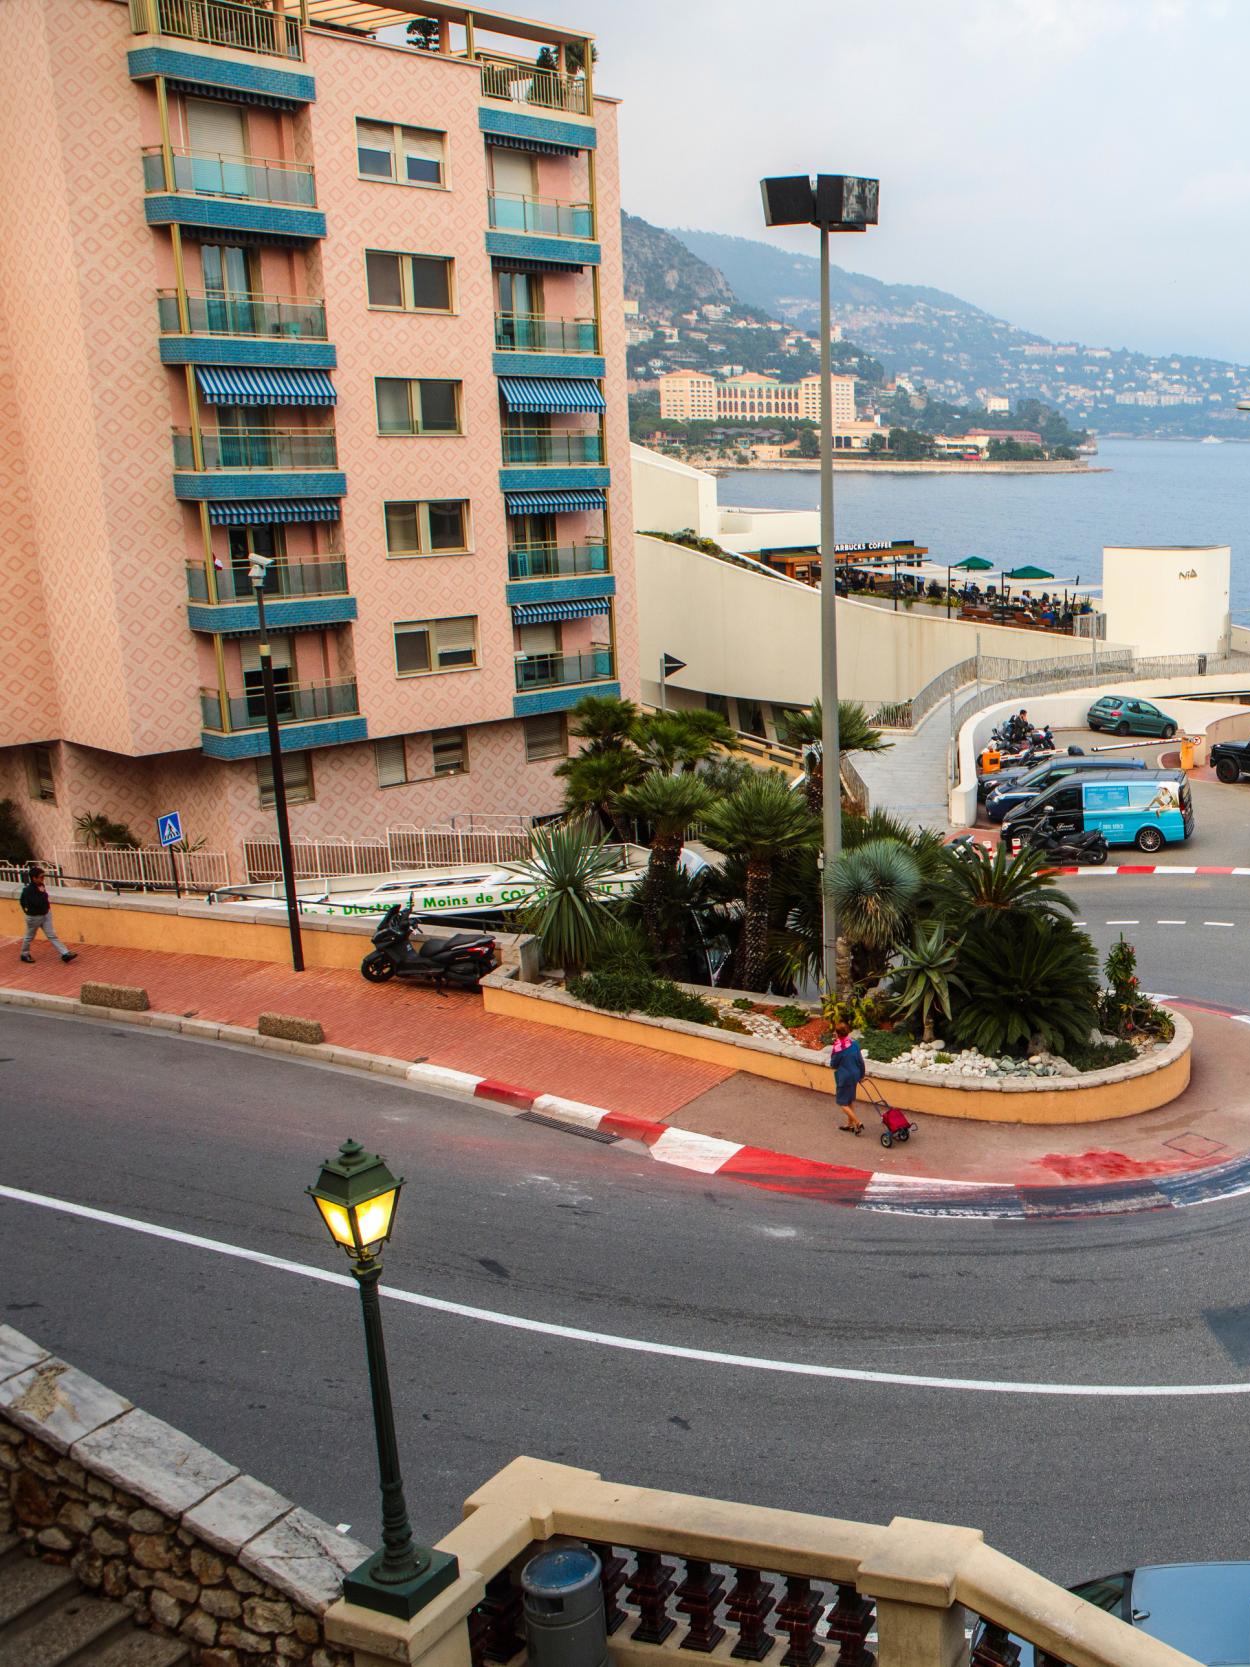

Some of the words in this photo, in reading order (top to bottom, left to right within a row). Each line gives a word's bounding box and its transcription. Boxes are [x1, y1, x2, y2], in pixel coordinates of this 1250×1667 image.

[834, 543, 866, 552] ARBUCKS
[868, 541, 892, 550] COFFEE
[423, 896, 469, 908] Moins
[475, 892, 494, 904] de
